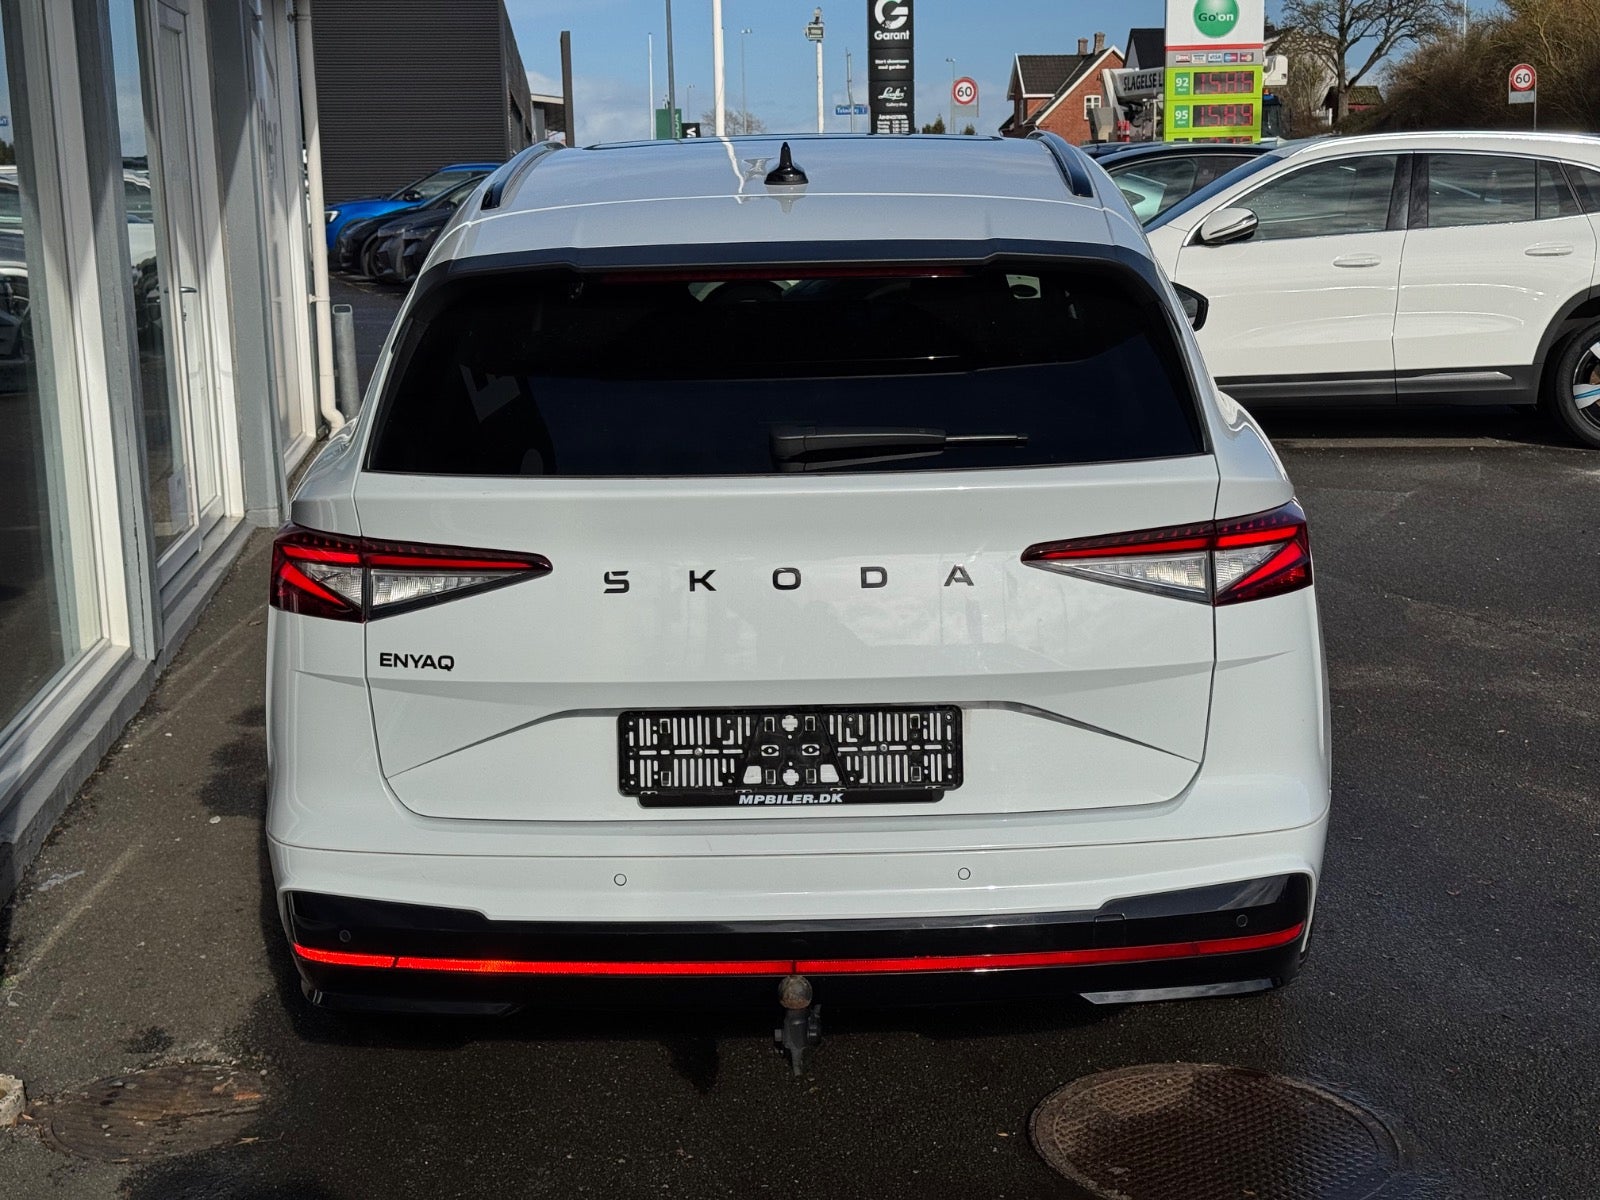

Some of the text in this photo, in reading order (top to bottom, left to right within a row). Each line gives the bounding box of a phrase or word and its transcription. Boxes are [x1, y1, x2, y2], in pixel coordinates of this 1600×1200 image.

[874, 30, 910, 40] Garant
[1123, 73, 1156, 91] SLAGELSE
[1175, 77, 1189, 87] 92
[1516, 73, 1530, 83] 60
[957, 86, 973, 97] 60
[1174, 104, 1253, 127] 95 1589
[603, 564, 975, 594] SKODA
[379, 652, 455, 672] ENYAQ
[738, 793, 844, 806] MPBILER.DK
